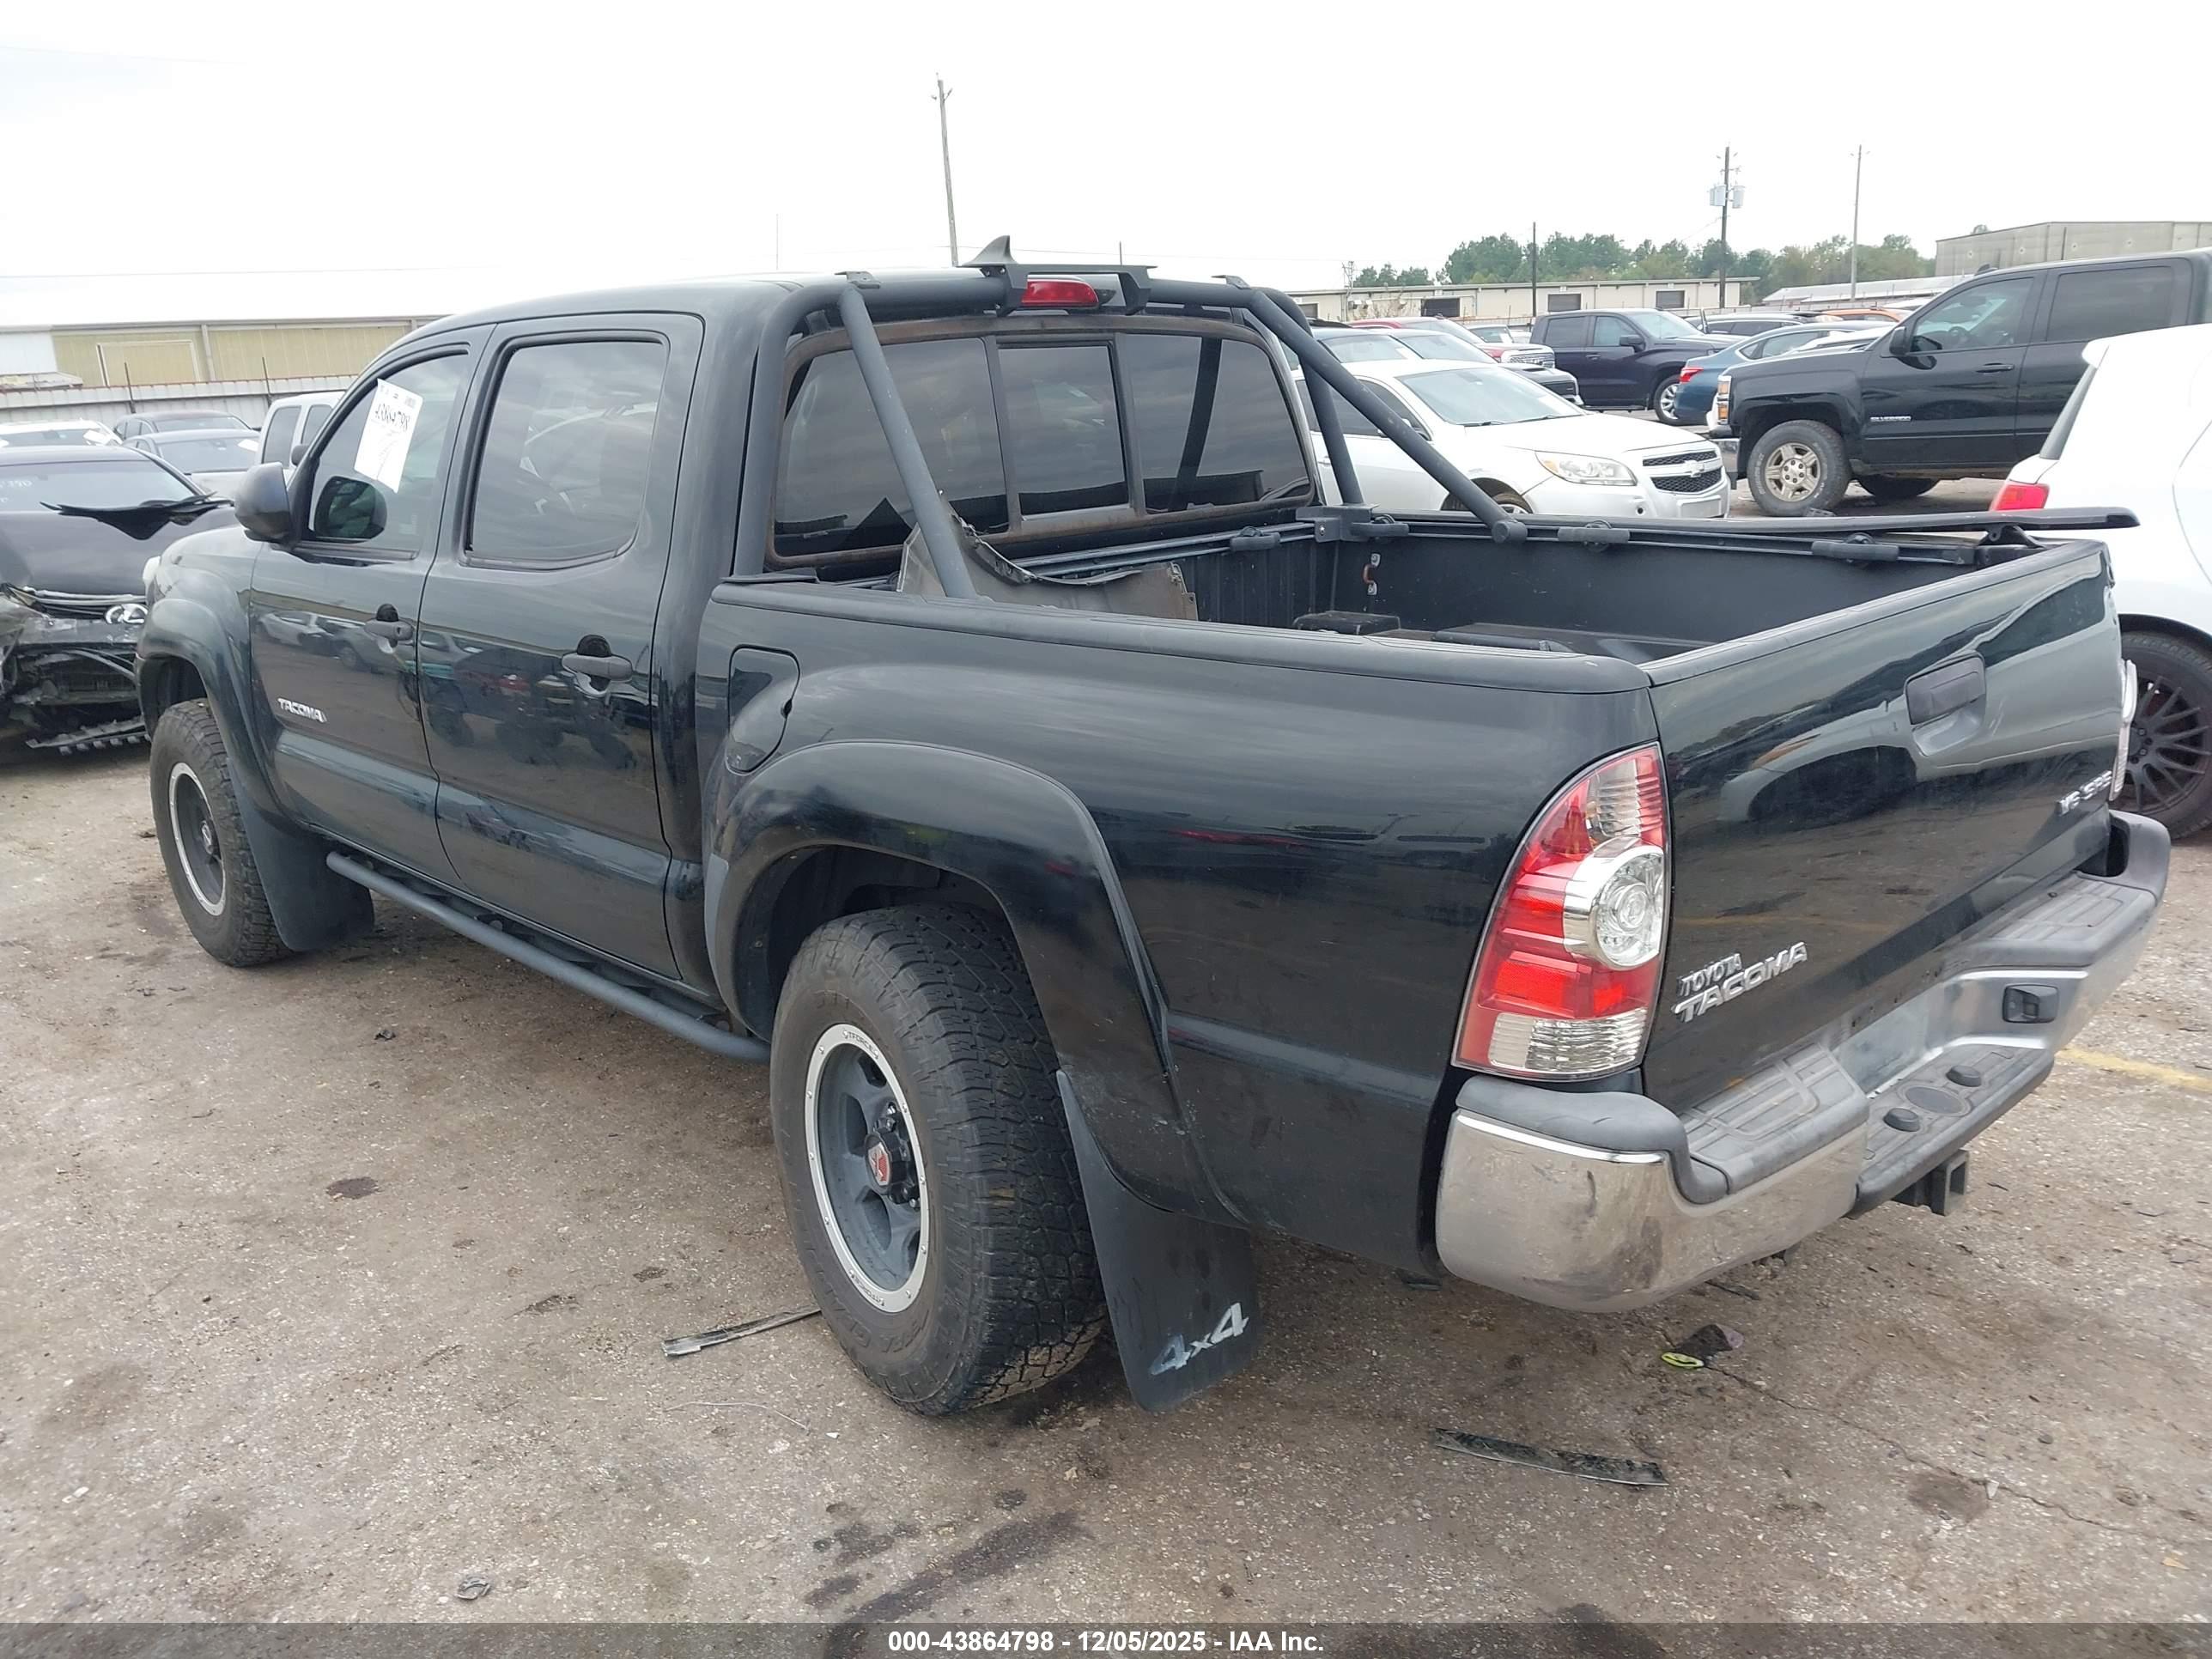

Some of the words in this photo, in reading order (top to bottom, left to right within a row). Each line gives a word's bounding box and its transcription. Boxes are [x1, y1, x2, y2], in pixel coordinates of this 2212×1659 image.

[277, 697, 327, 723] TACOMA
[1673, 941, 1808, 1023] TACOMA
[1678, 952, 1743, 996] TOYOTA
